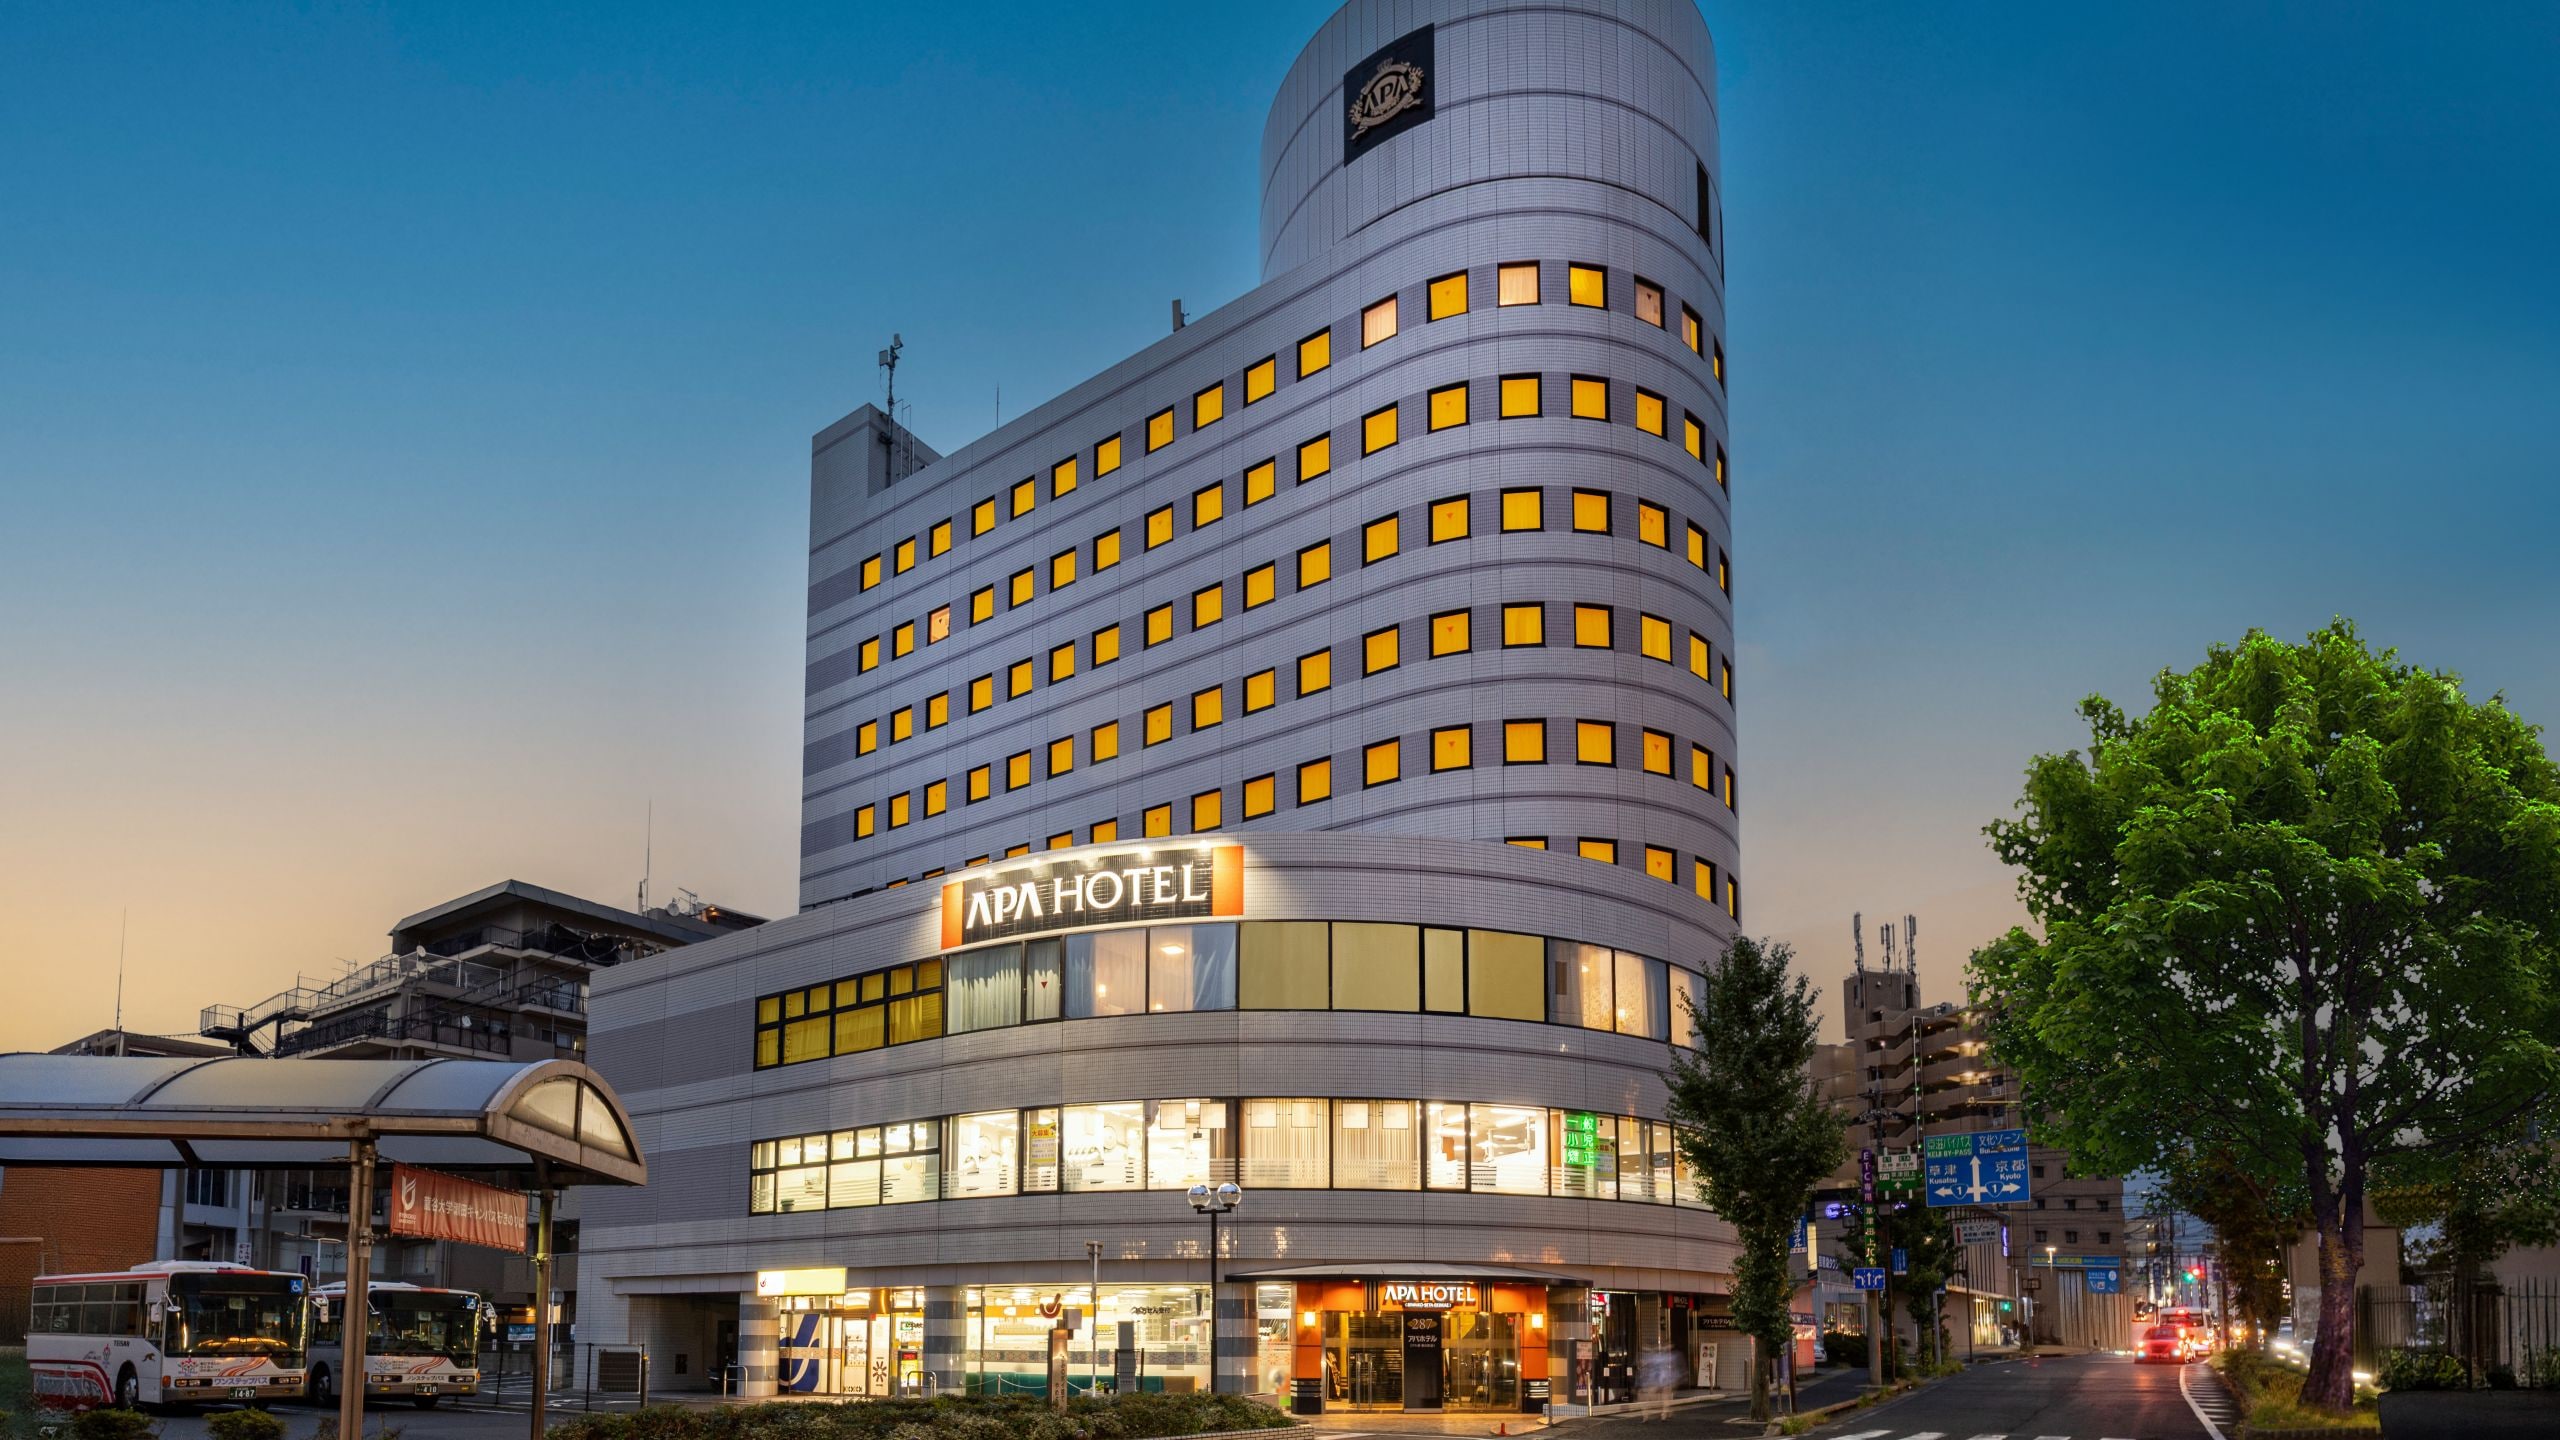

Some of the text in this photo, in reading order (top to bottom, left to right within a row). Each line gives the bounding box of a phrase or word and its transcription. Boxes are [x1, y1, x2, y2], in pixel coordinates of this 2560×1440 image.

[1364, 75, 1408, 114] APA
[966, 864, 1208, 929] APA HOTEL
[1567, 1132, 1593, 1147] 小児
[1929, 1165, 1957, 1176] 草津
[1995, 1160, 2025, 1172] 京都
[1957, 1186, 1962, 1195] 1
[1991, 1184, 1997, 1193] 1
[1384, 1285, 1475, 1302] APA HOTEL
[1411, 1318, 1433, 1330] 287
[1408, 1335, 1438, 1343] アパホテル
[213, 1377, 268, 1386] ワンステップバス
